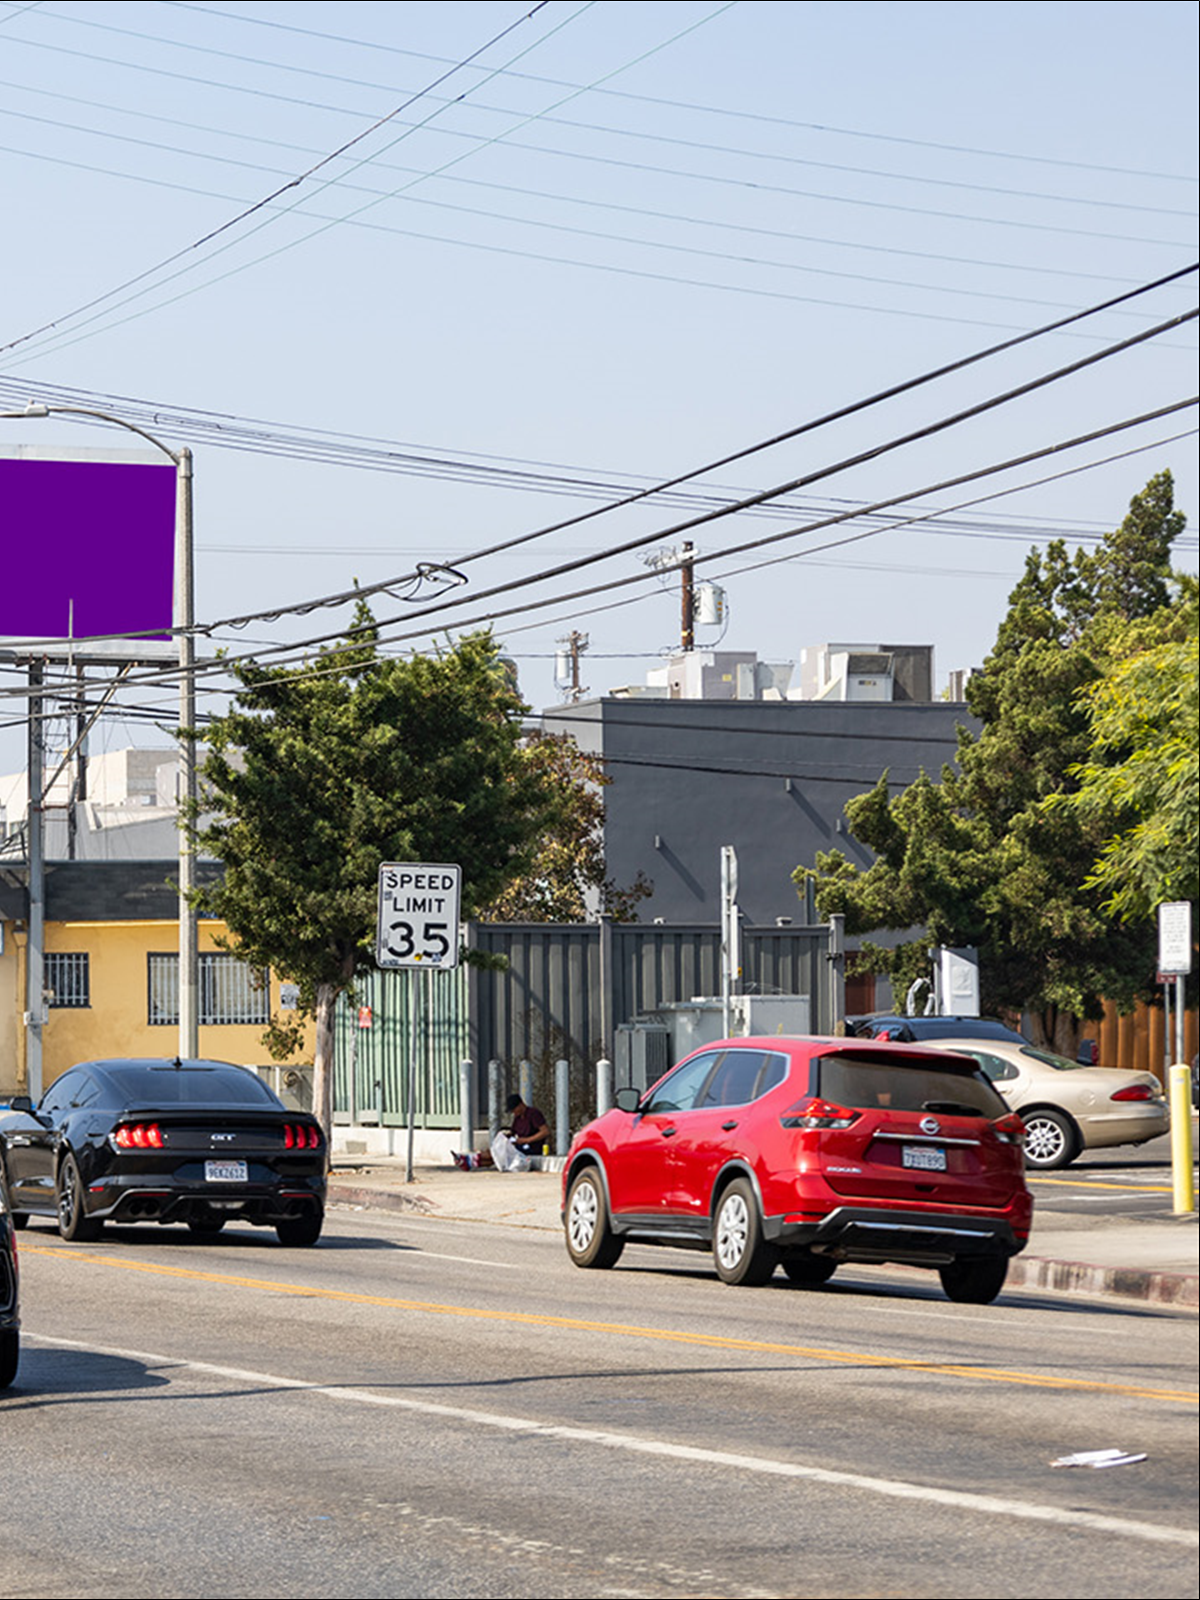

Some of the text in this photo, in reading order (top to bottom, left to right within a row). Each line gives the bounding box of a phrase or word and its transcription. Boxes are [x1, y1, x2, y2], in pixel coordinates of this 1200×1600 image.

[386, 872, 454, 890] SPEED
[393, 897, 446, 913] LIMIT
[387, 921, 450, 958] 35
[211, 1133, 236, 1141] GT
